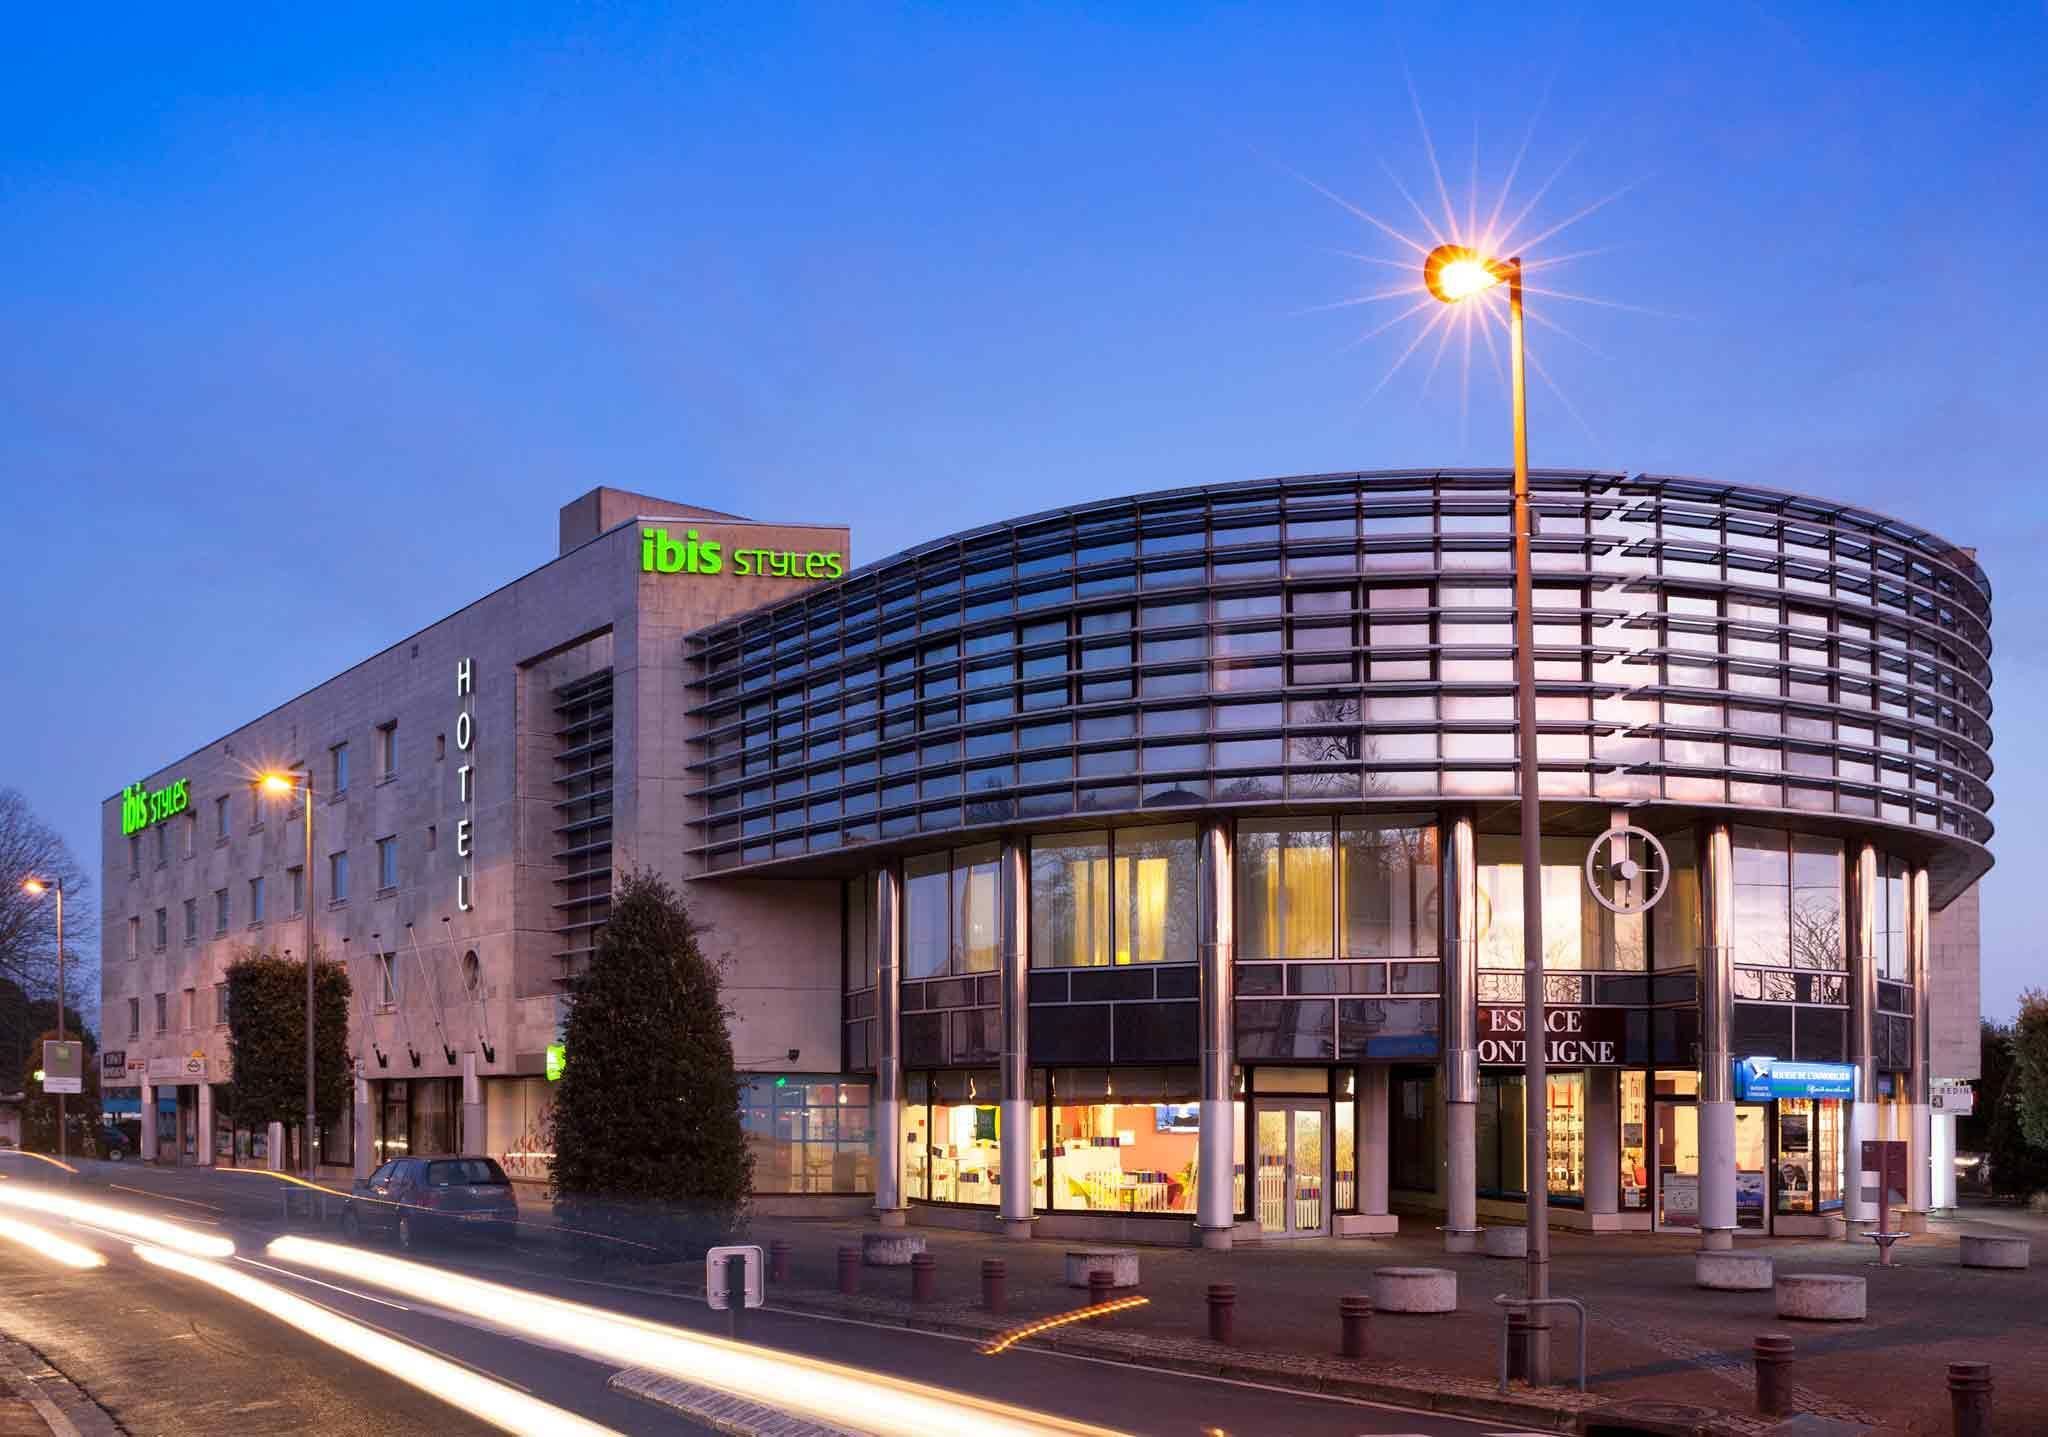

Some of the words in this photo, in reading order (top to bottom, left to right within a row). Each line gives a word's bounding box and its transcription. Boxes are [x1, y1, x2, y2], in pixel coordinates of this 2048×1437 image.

[642, 527, 722, 574] ibis
[123, 782, 147, 835] ibis
[457, 657, 471, 911] HOTEL
[1489, 1009, 1582, 1033] ESCE
